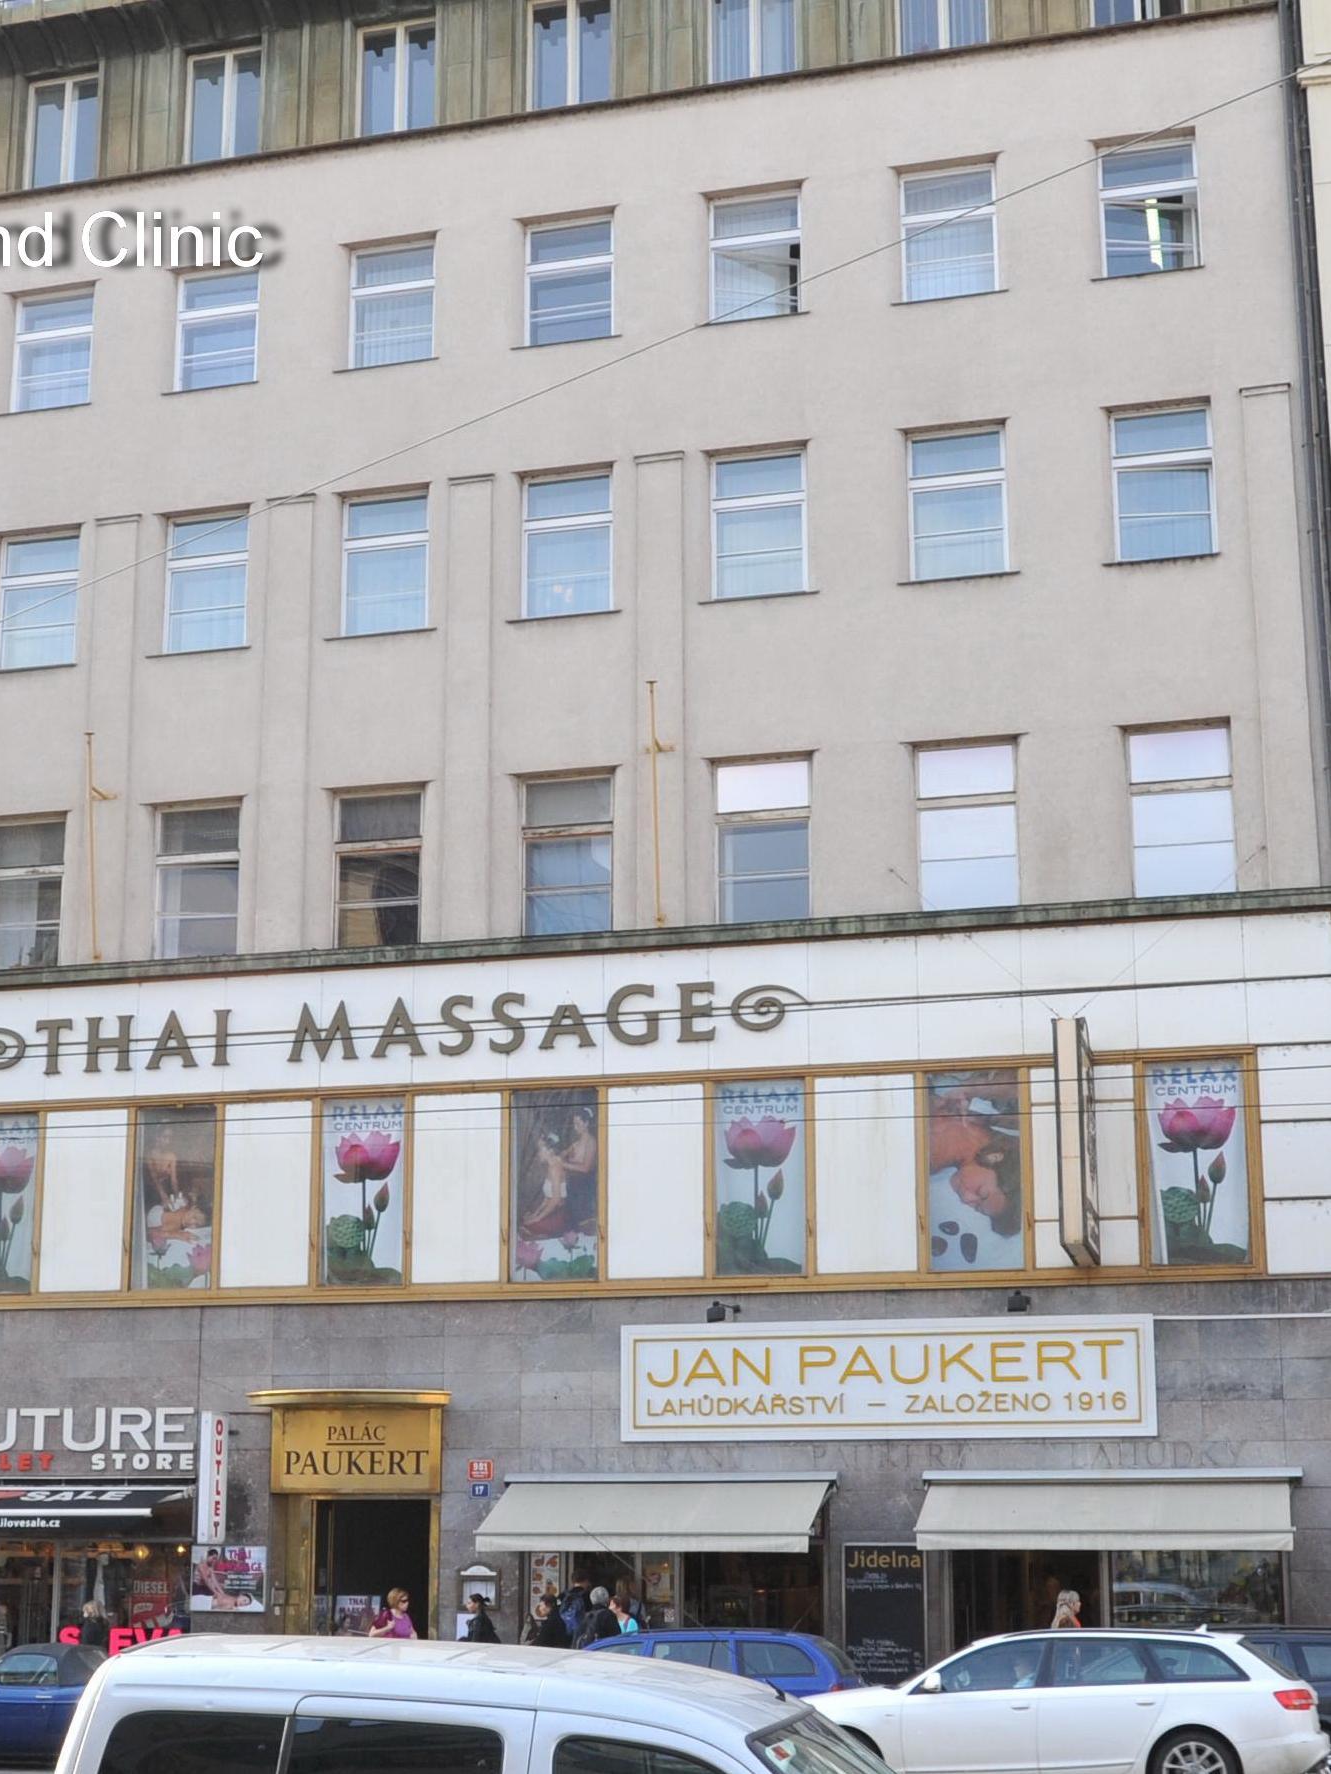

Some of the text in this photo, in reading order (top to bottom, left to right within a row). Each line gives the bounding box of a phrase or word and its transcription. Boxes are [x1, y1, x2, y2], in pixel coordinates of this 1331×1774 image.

[36, 981, 717, 1074] THAI MASSAGE
[1152, 1065, 1237, 1084] RELAX
[722, 1087, 799, 1103] RELAX
[1155, 1084, 1237, 1096] CENTRUM
[333, 1103, 403, 1120] RELAX
[723, 1104, 798, 1114] CENTRUM
[333, 1120, 402, 1131] CENTRUM
[647, 1340, 1124, 1387] JAN PAUKERT
[647, 1394, 845, 1417] LAHŮDKÁŘSTVÍ
[904, 1391, 1052, 1414] ZALOŽENO
[1063, 1391, 1127, 1412] 1916
[327, 1421, 386, 1441] PALÁC
[92, 1453, 194, 1470] STORE
[284, 1450, 429, 1476] PAUKERT
[211, 1418, 223, 1539] OUTLET
[19, 1490, 132, 1501] SALE
[475, 1485, 484, 1495] 17
[848, 1550, 922, 1568] Jídelna
[132, 1580, 170, 1594] DIESEL
[59, 1625, 183, 1657] SEV
